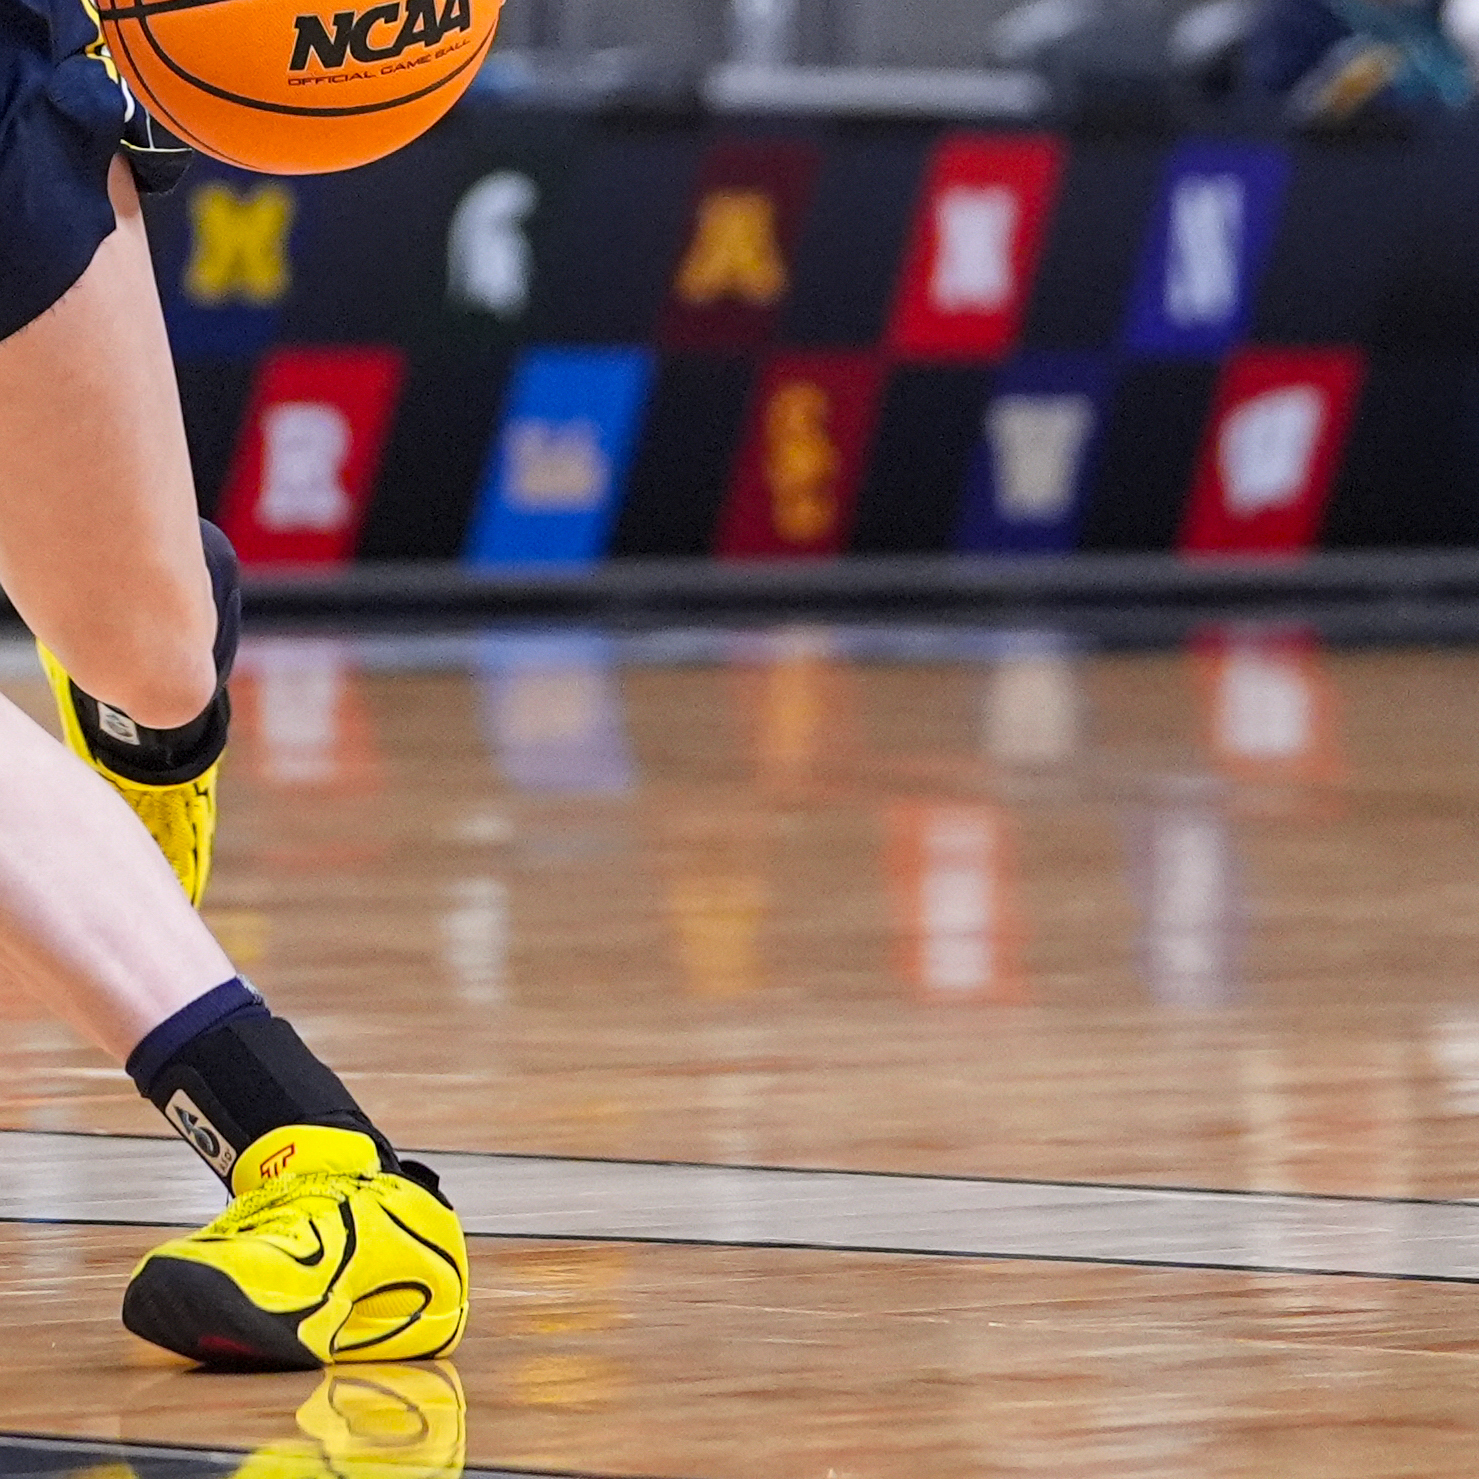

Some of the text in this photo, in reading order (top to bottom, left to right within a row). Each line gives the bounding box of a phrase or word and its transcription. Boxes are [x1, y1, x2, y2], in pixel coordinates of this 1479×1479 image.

[287, 38, 472, 87] OFFICIAL GAME BALL
